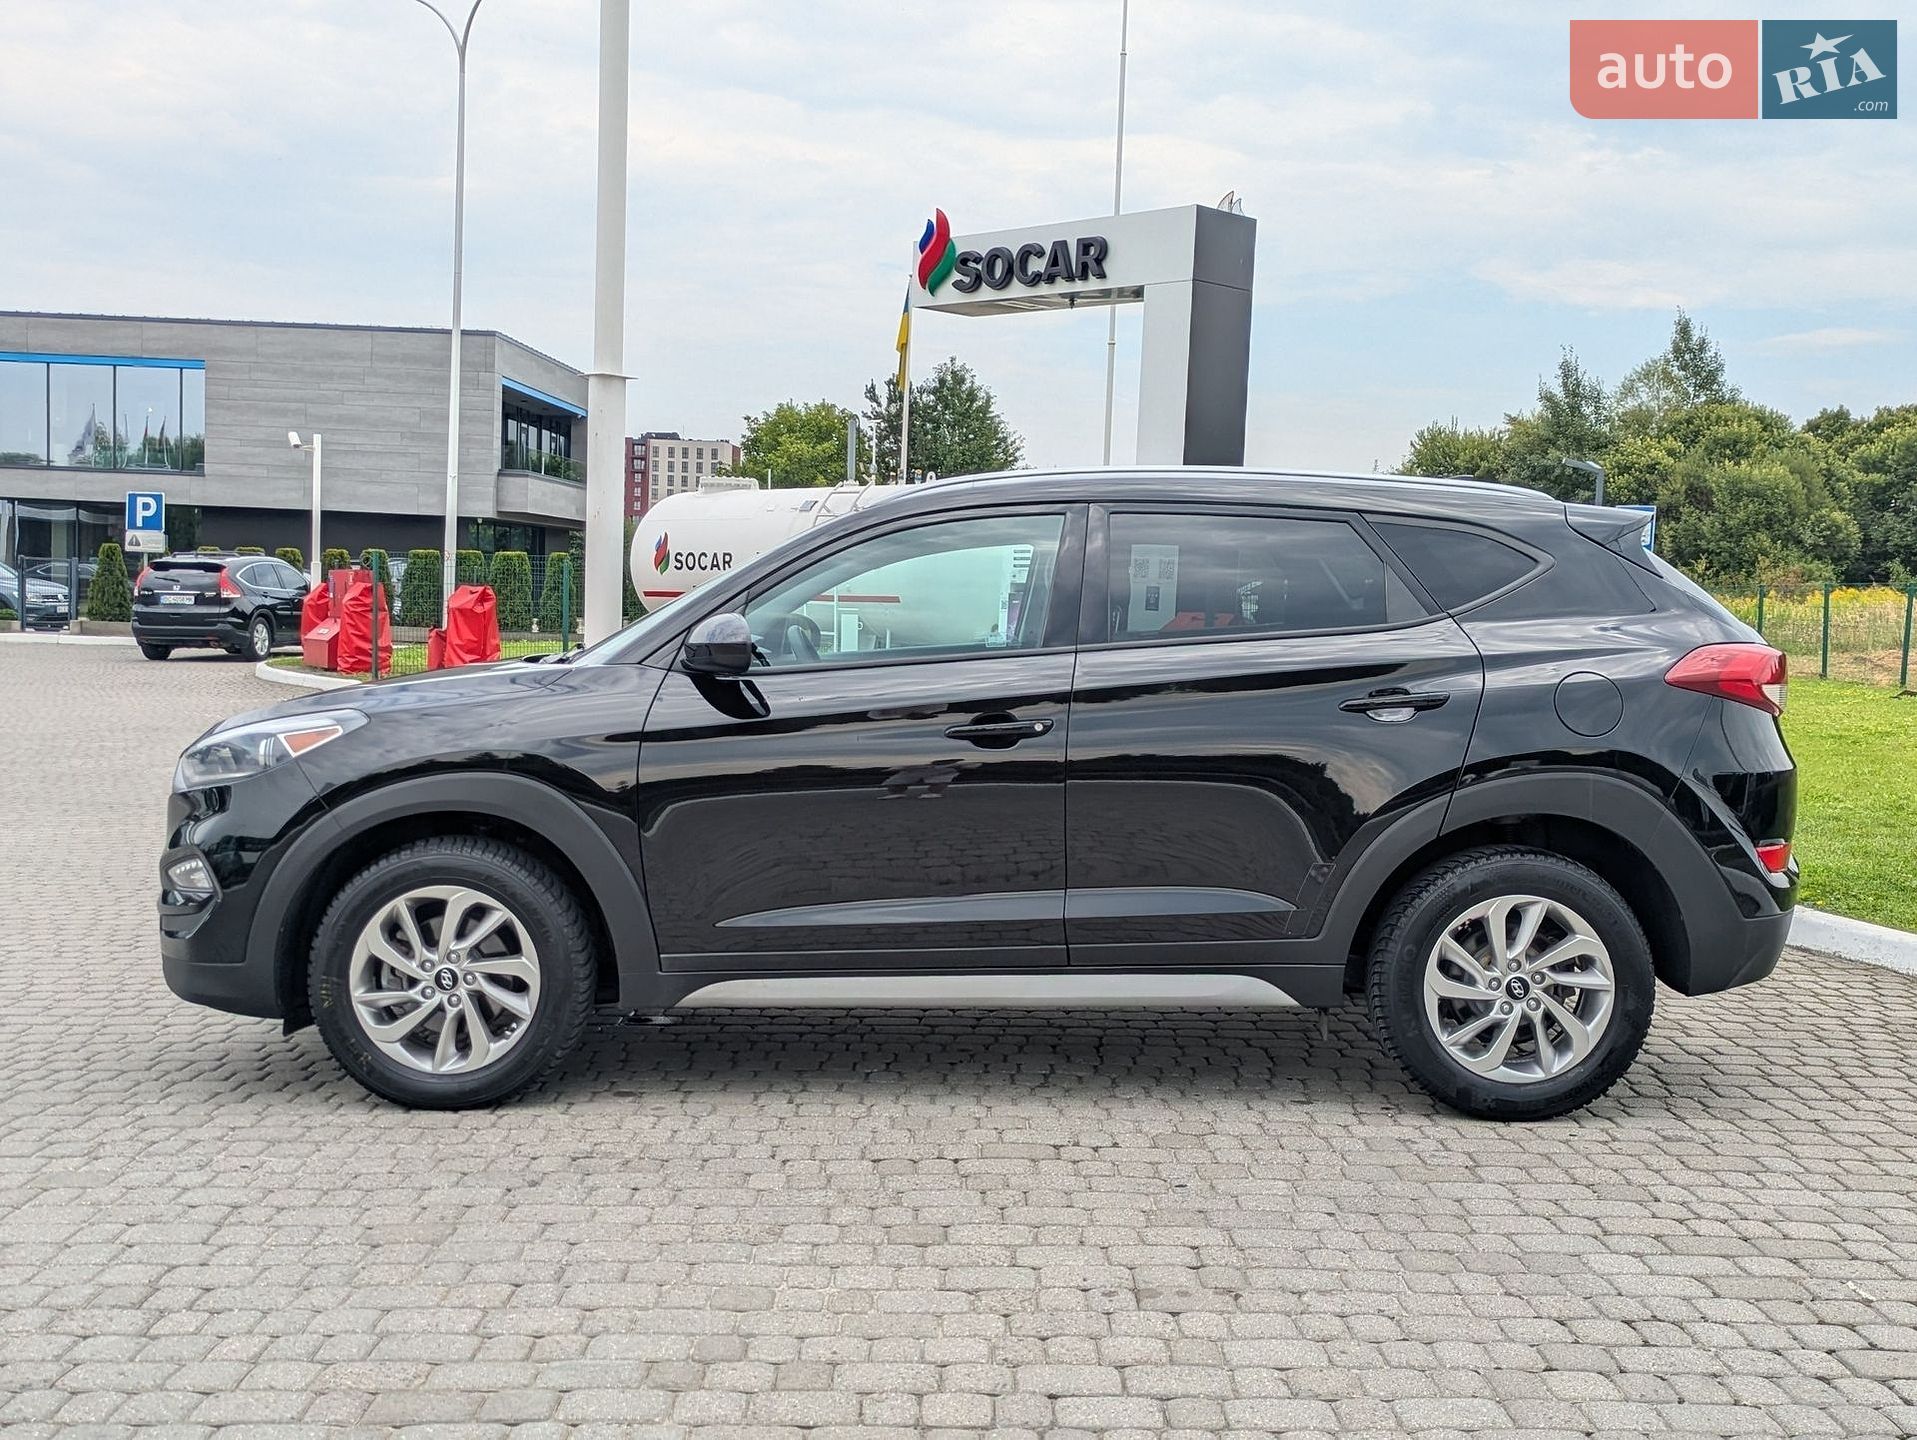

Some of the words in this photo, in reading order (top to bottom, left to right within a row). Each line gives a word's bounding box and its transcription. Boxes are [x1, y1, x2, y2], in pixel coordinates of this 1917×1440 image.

[952, 236, 1108, 293] SOCAR
[136, 496, 157, 527] P
[674, 551, 733, 571] SOCAR
